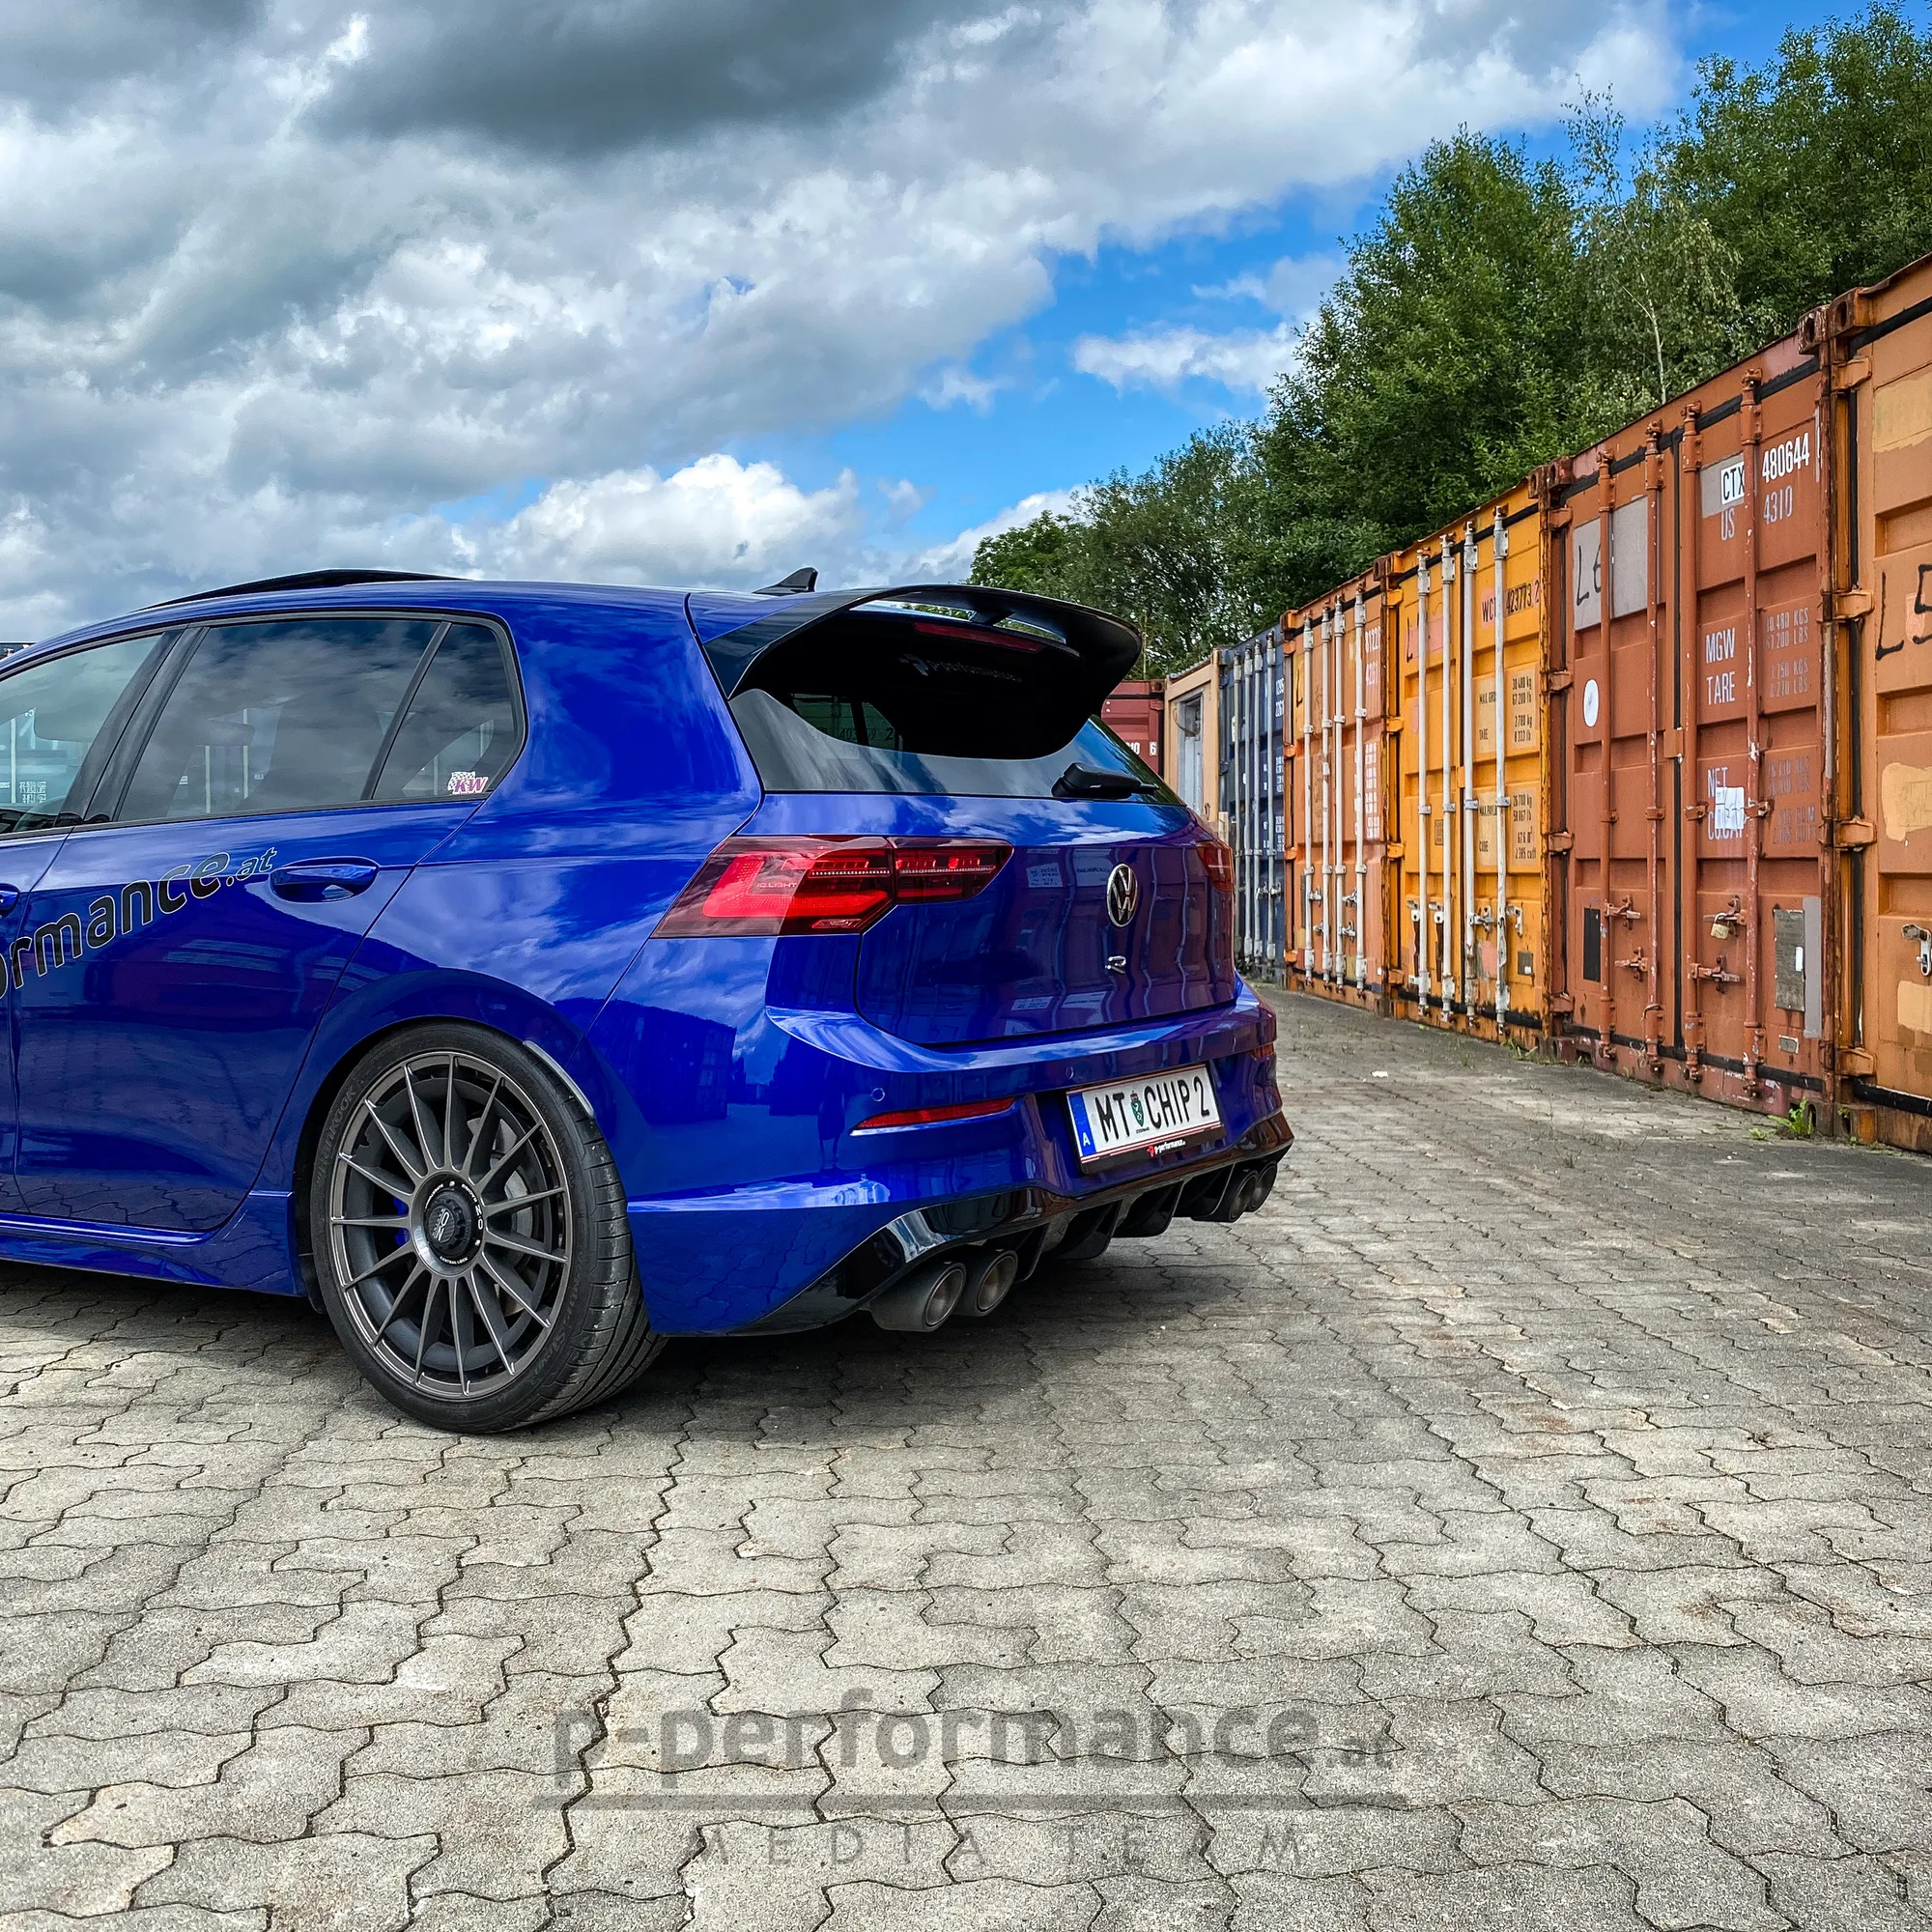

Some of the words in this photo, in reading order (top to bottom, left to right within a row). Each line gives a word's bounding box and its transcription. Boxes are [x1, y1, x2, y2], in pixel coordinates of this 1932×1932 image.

[1762, 433, 1809, 483] 480644
[1763, 485, 1793, 526] 4310
[1720, 507, 1736, 541] US
[1505, 582, 1532, 613] 423773
[1534, 580, 1540, 603] 2
[1793, 608, 1809, 626] KGS
[1705, 628, 1736, 664] MGW
[1793, 626, 1809, 644] LBS
[1793, 658, 1809, 676] KGS
[1706, 671, 1736, 706] TARE
[1793, 676, 1809, 695] LBS
[454, 777, 489, 793] KW
[0, 847, 277, 999] rmance.at
[1082, 1132, 1091, 1147] A
[1094, 1092, 1130, 1143] MT
[1144, 1078, 1190, 1129] CHIP
[1193, 1075, 1210, 1118] 2
